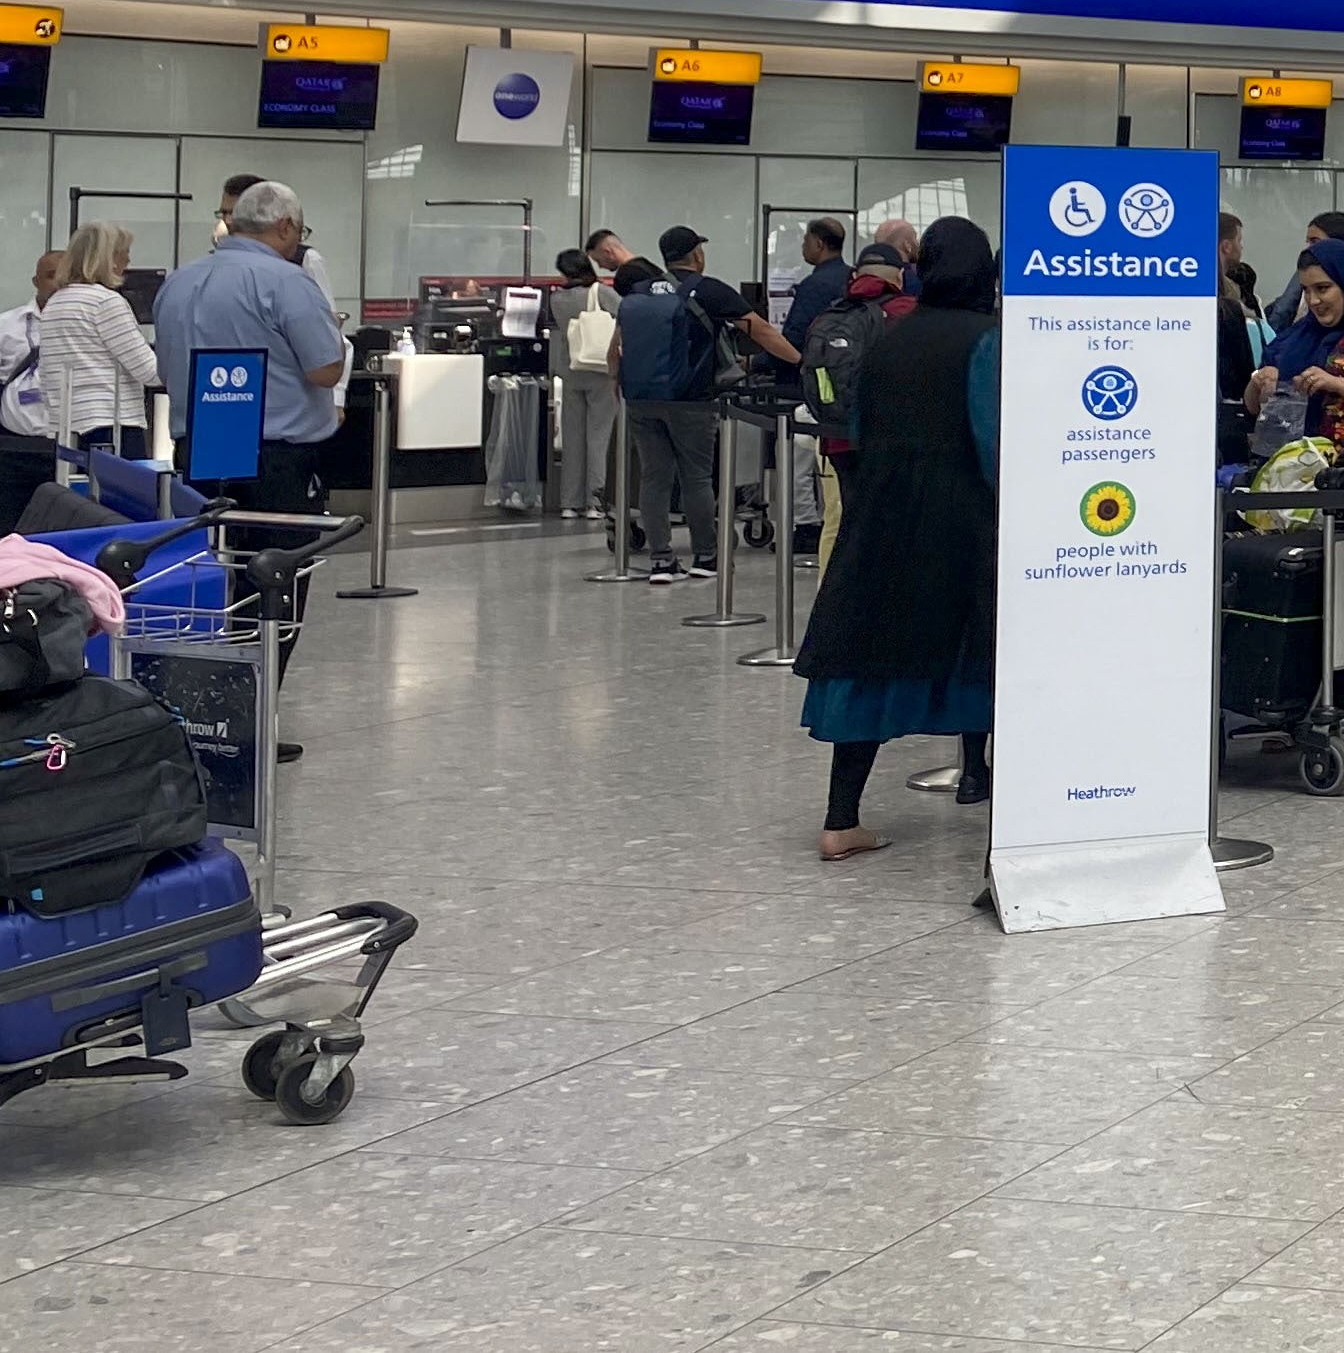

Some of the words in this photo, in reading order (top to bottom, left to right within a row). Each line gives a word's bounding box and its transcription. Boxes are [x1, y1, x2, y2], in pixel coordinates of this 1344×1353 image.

[298, 36, 318, 49] A5
[681, 60, 700, 71] A6
[947, 73, 964, 83] A7
[1265, 86, 1281, 96] A8
[1023, 249, 1199, 278] Assistance
[1028, 316, 1062, 331] This
[1066, 317, 1151, 331] assistance
[1156, 316, 1192, 331] lane
[1087, 335, 1100, 351] is
[1103, 335, 1134, 351] for:
[201, 391, 255, 402] Assistance
[1066, 427, 1152, 442] assistance
[1061, 446, 1156, 465] passengers
[1056, 543, 1115, 563] people
[1119, 541, 1158, 556] with
[1024, 563, 1112, 580] sunflower
[1116, 558, 1187, 579] lanyards
[1067, 785, 1137, 801] Heathrow
